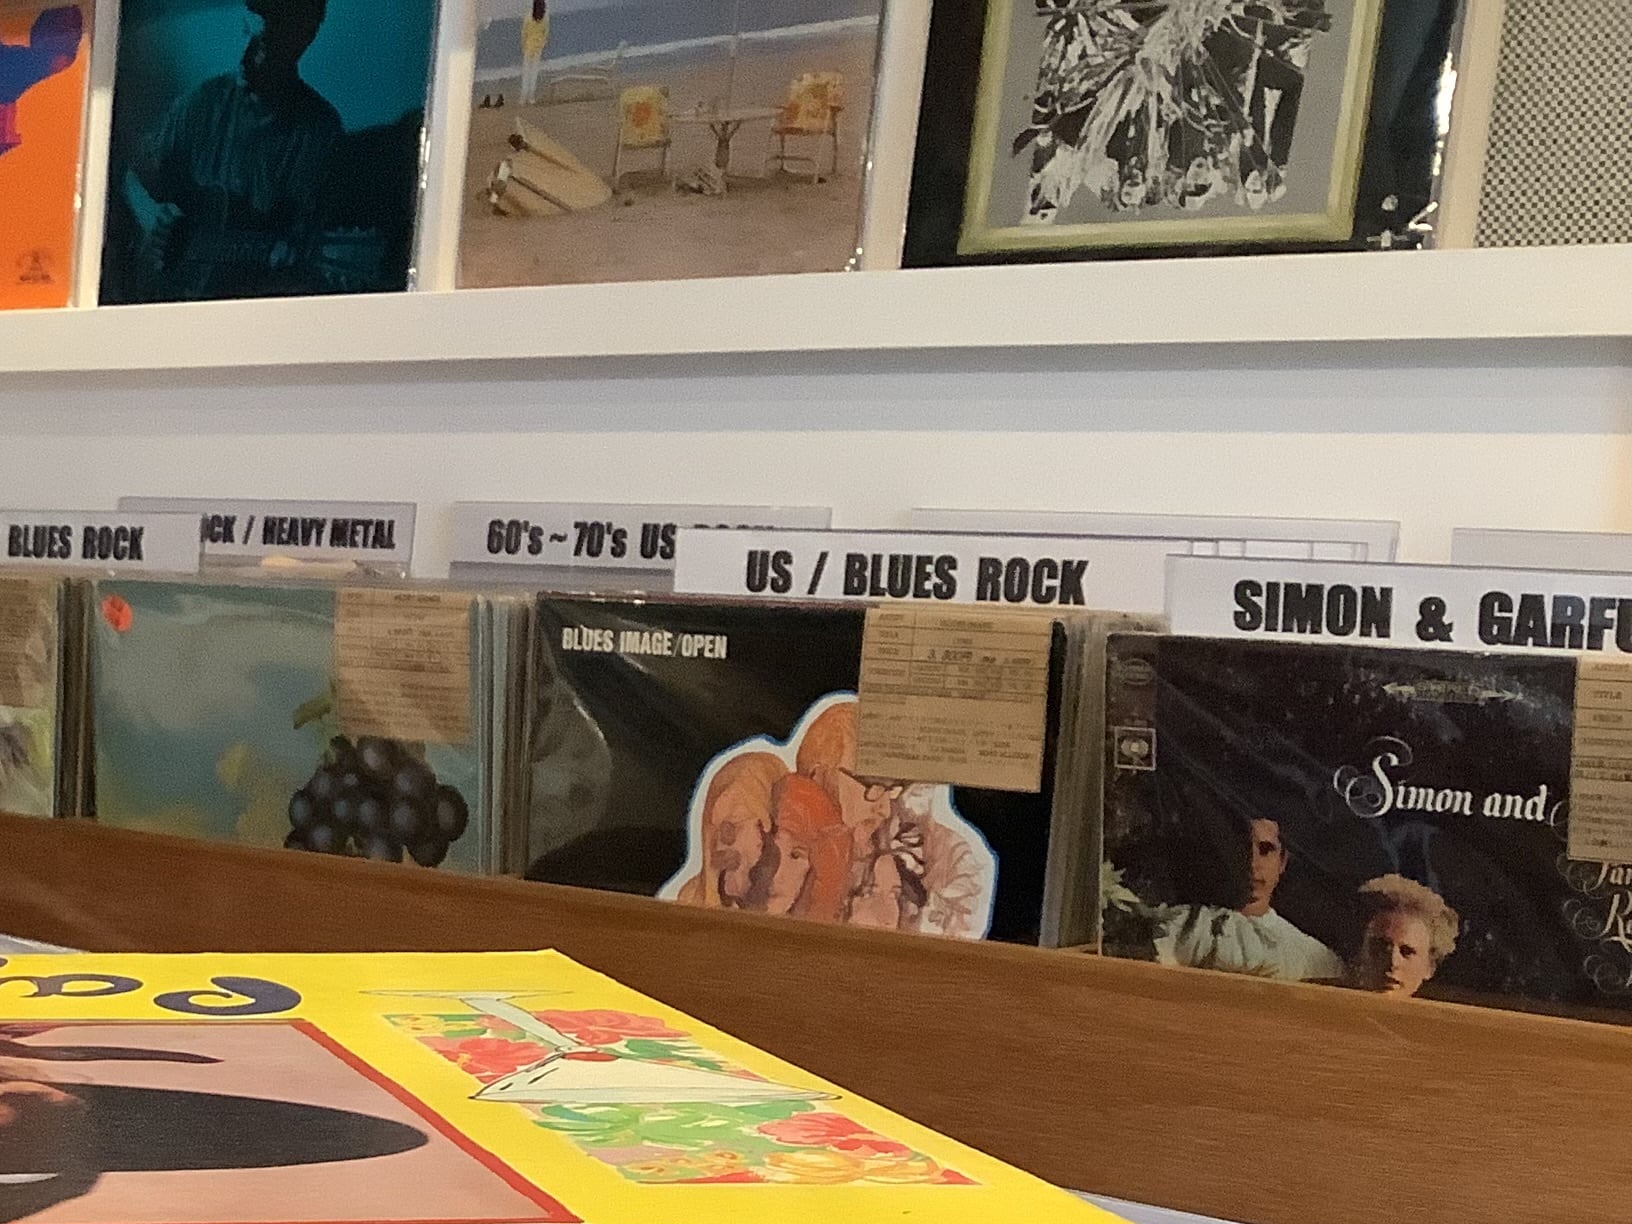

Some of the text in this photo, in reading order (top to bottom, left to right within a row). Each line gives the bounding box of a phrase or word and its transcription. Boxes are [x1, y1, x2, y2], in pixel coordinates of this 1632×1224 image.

[8, 525, 72, 558] BLUES
[81, 526, 144, 561] ROCK
[243, 514, 254, 544] /
[263, 516, 327, 547] HEAVY
[330, 518, 396, 550] METAL
[746, 550, 1090, 606] US / BLUES ROCK
[1233, 579, 1393, 639] SIMON
[1416, 596, 1454, 642] &
[562, 626, 727, 659] BLUES IMAGE/OPEN
[1333, 735, 1547, 821] Simon and
